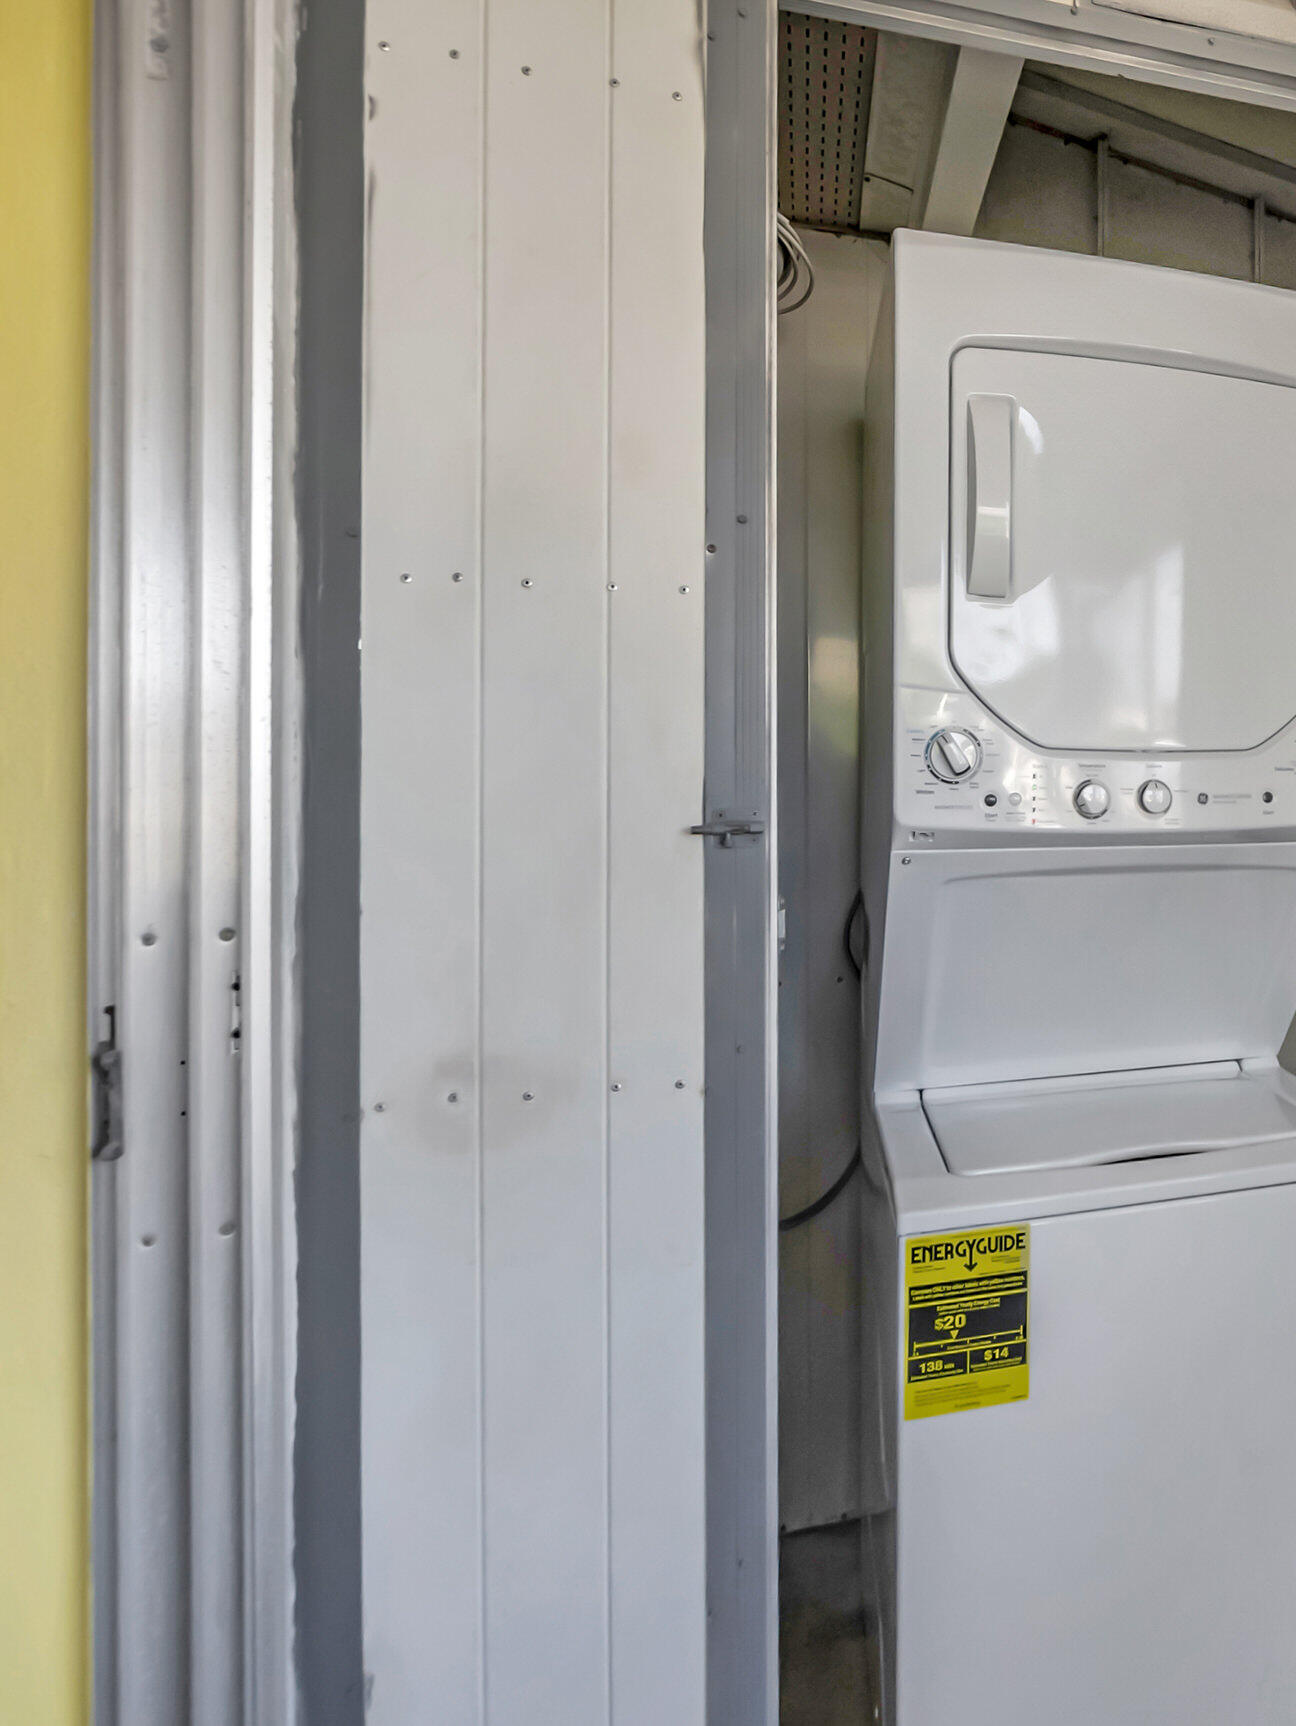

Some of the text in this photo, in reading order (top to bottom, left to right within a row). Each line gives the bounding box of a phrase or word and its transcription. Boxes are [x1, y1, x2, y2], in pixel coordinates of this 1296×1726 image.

[911, 1232, 1026, 1265] ENERGYGUIDE
[934, 1313, 967, 1331] $20
[984, 1346, 1009, 1361] $14
[919, 1360, 943, 1373] 138
